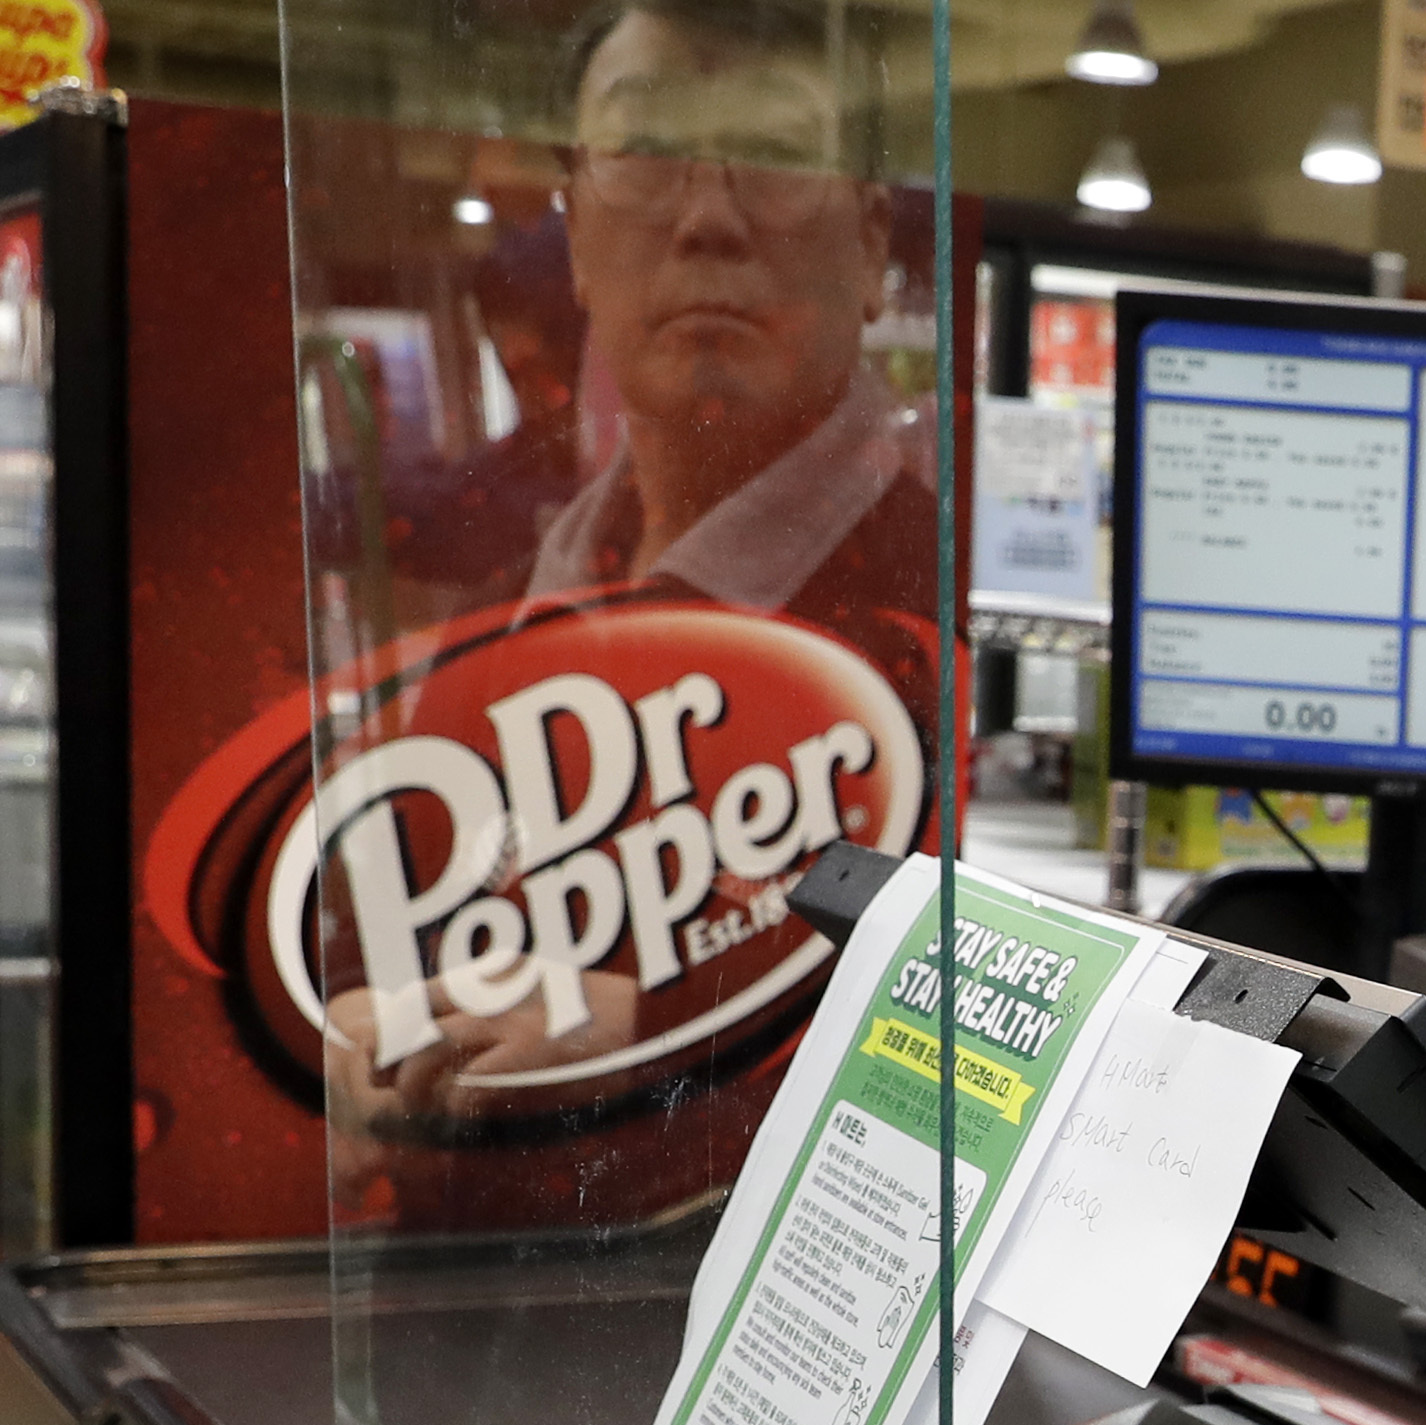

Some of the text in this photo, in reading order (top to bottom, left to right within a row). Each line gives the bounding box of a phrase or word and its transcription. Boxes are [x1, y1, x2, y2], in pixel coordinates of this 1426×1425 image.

[1264, 699, 1336, 732] 0.00
[487, 673, 724, 874] Dr
[335, 719, 875, 1070] Pepper
[925, 917, 1078, 1002] STAY SAFE &
[890, 957, 1063, 1058] STAY HEALTHY
[956, 1057, 1012, 1099] 다하겠습니다.
[1147, 1136, 1202, 1179] Card
